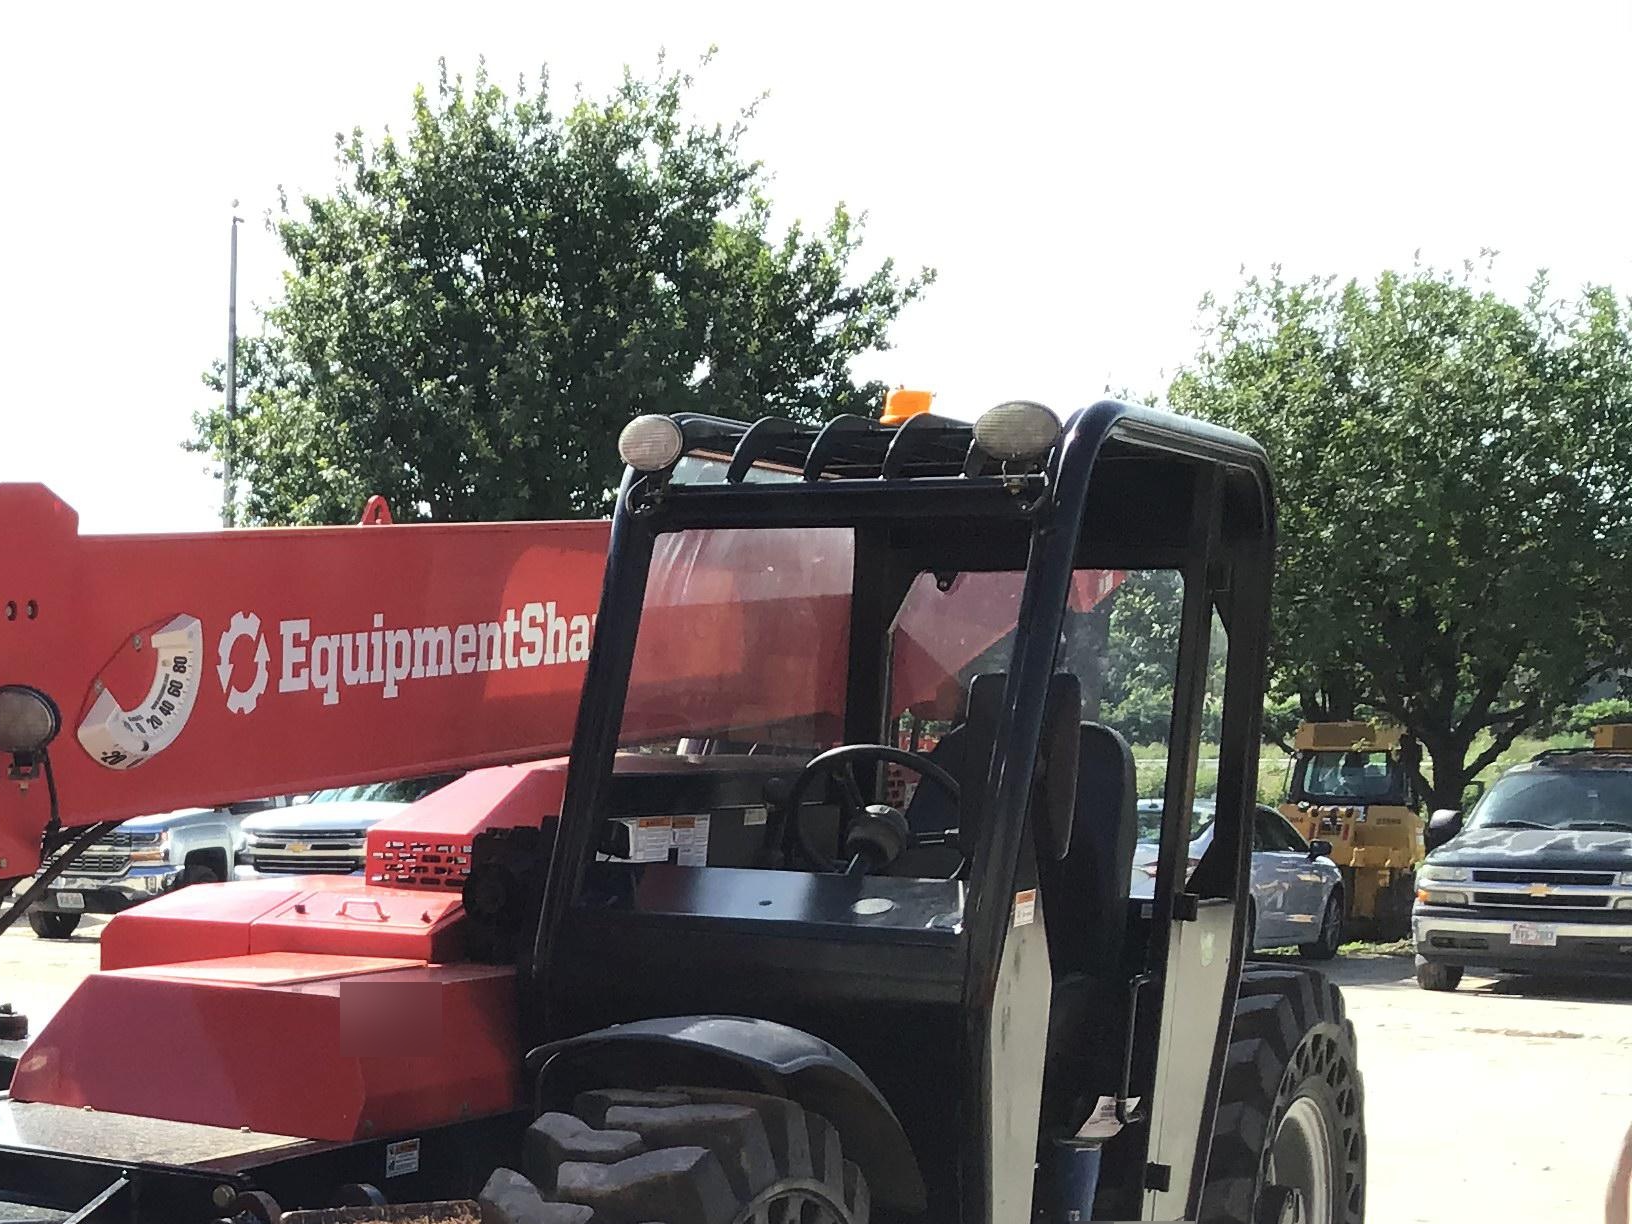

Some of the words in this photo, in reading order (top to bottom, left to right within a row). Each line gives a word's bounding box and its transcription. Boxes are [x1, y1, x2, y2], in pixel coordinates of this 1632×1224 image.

[279, 601, 598, 706] EquipmentSha
[173, 655, 188, 673] 80
[167, 679, 184, 698] 60
[158, 700, 175, 717] 40
[146, 714, 163, 730] 20
